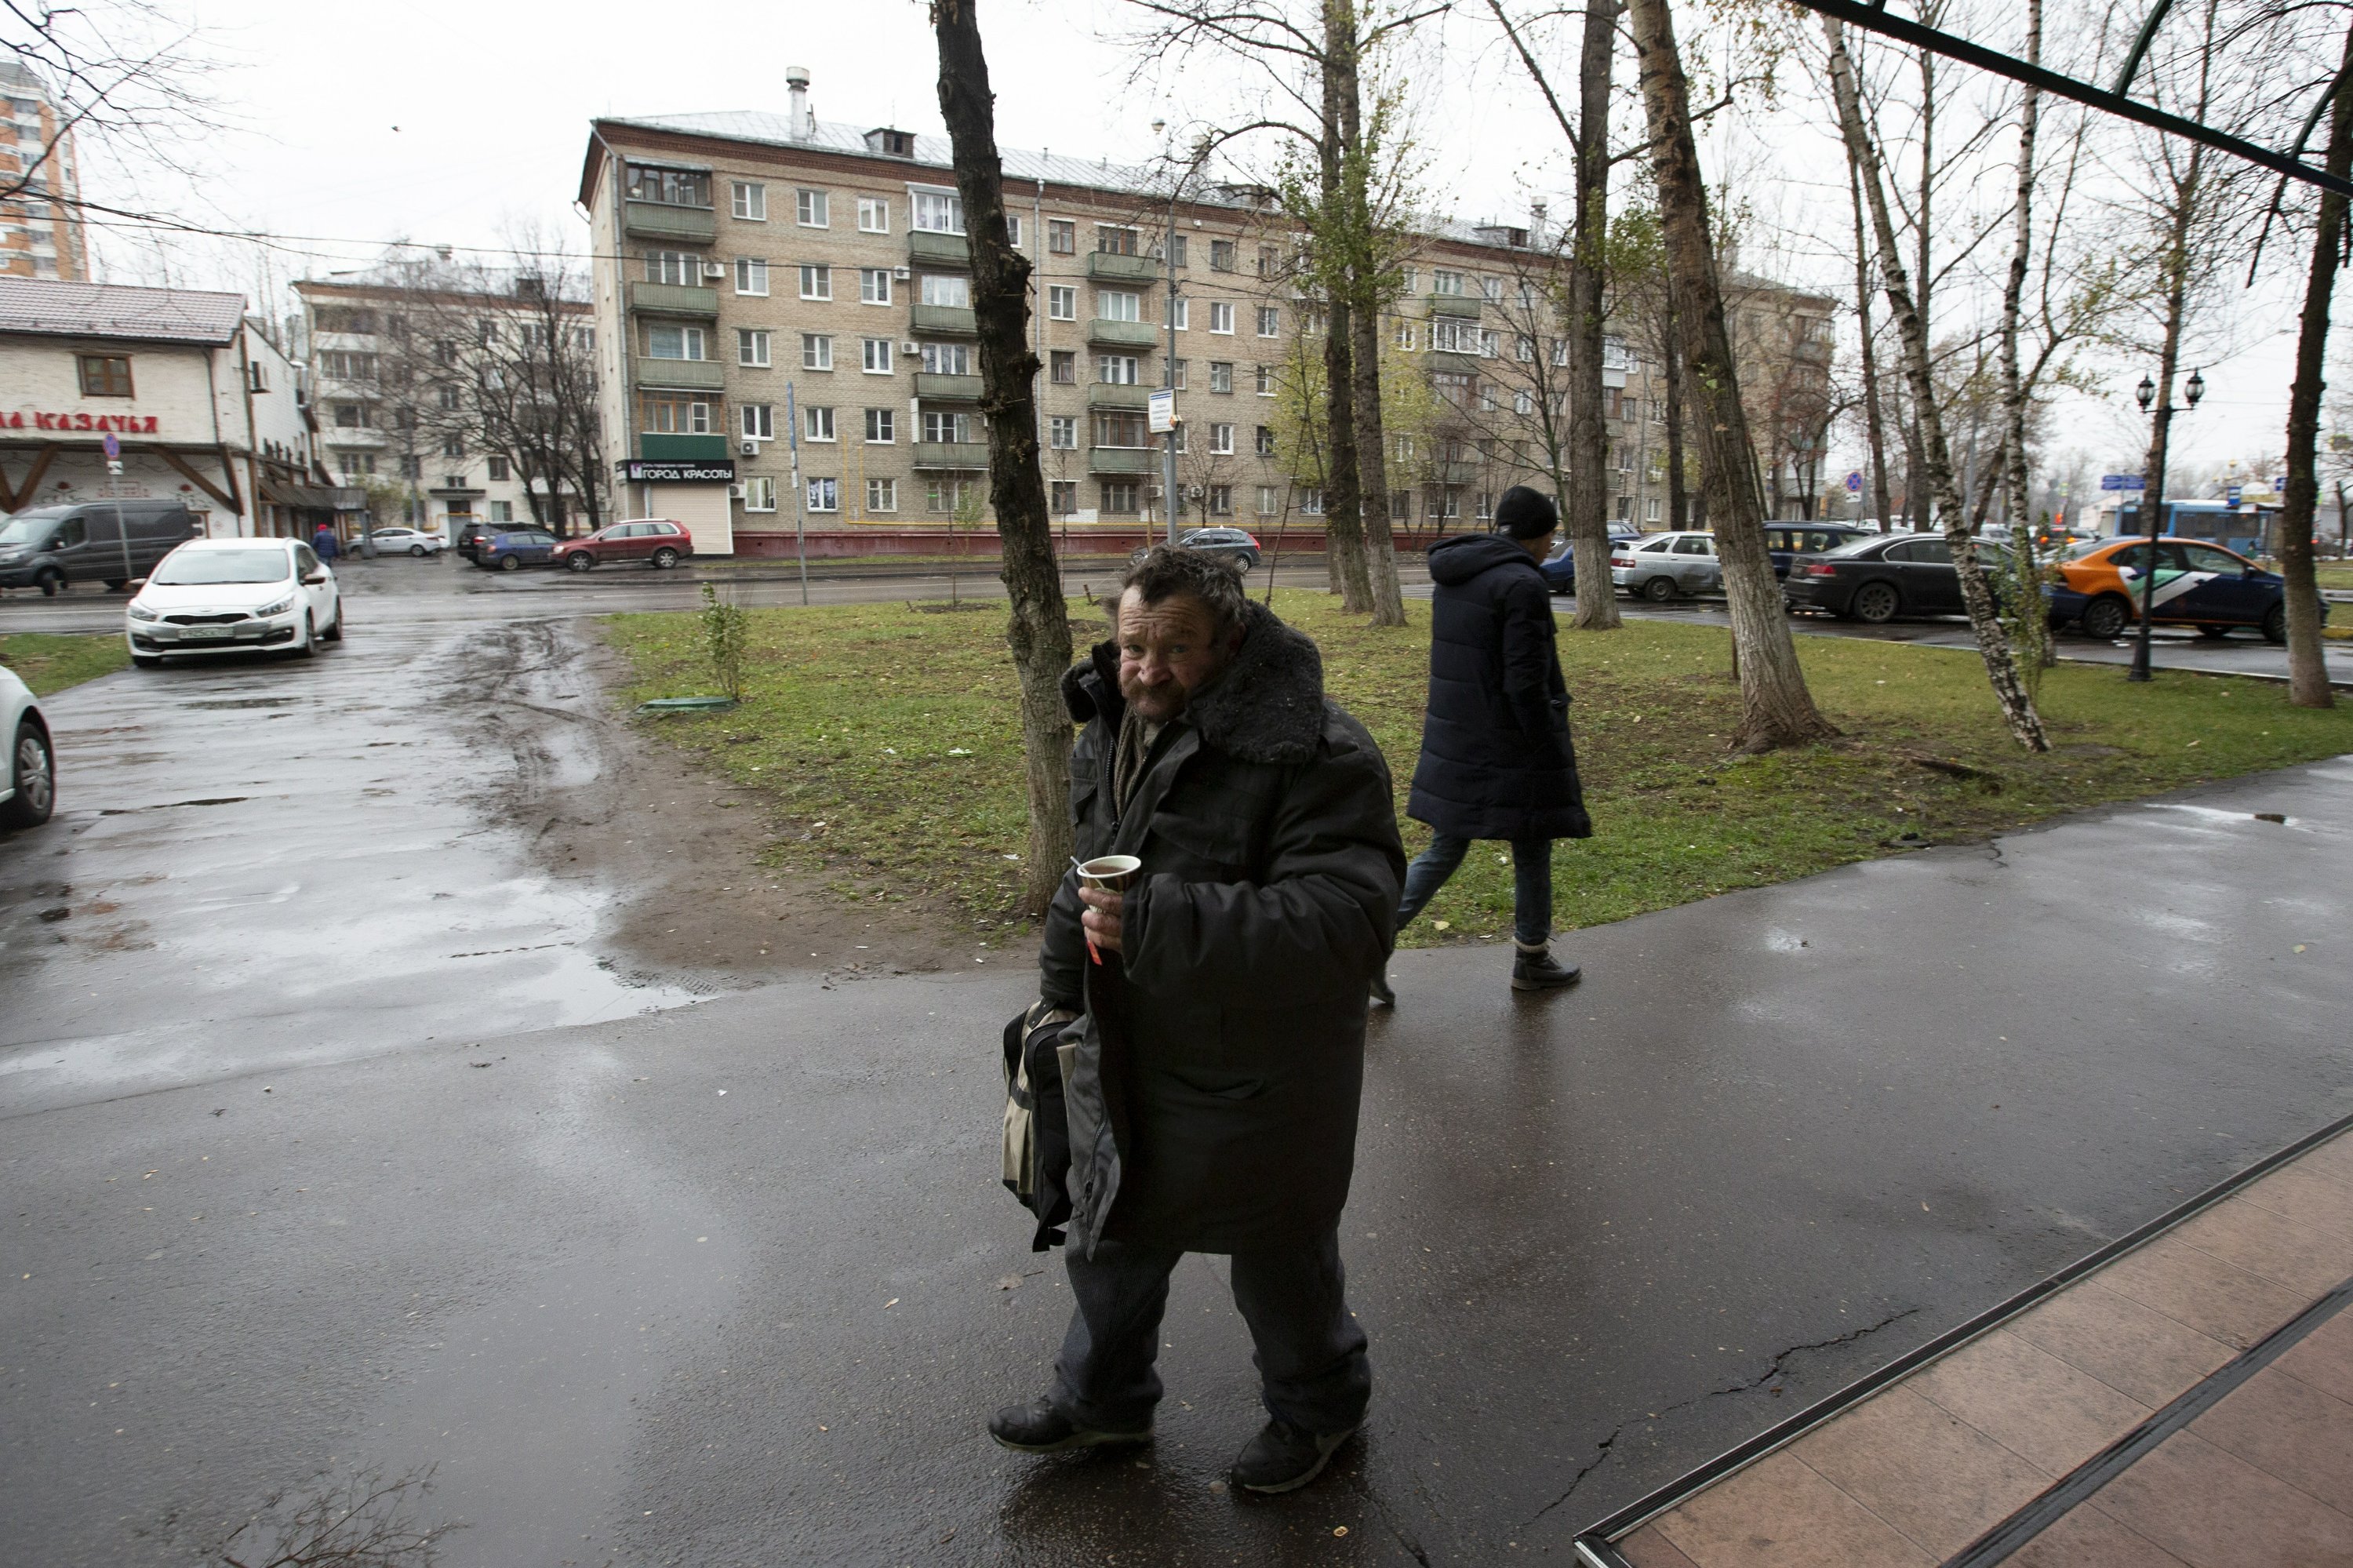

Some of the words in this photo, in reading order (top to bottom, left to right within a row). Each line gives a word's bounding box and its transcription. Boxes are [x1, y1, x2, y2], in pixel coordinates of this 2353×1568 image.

[35, 412, 158, 433] КАЗАЧЬЯ
[642, 470, 681, 478] ГОРОД
[683, 470, 733, 478] КРАСОТЫ
